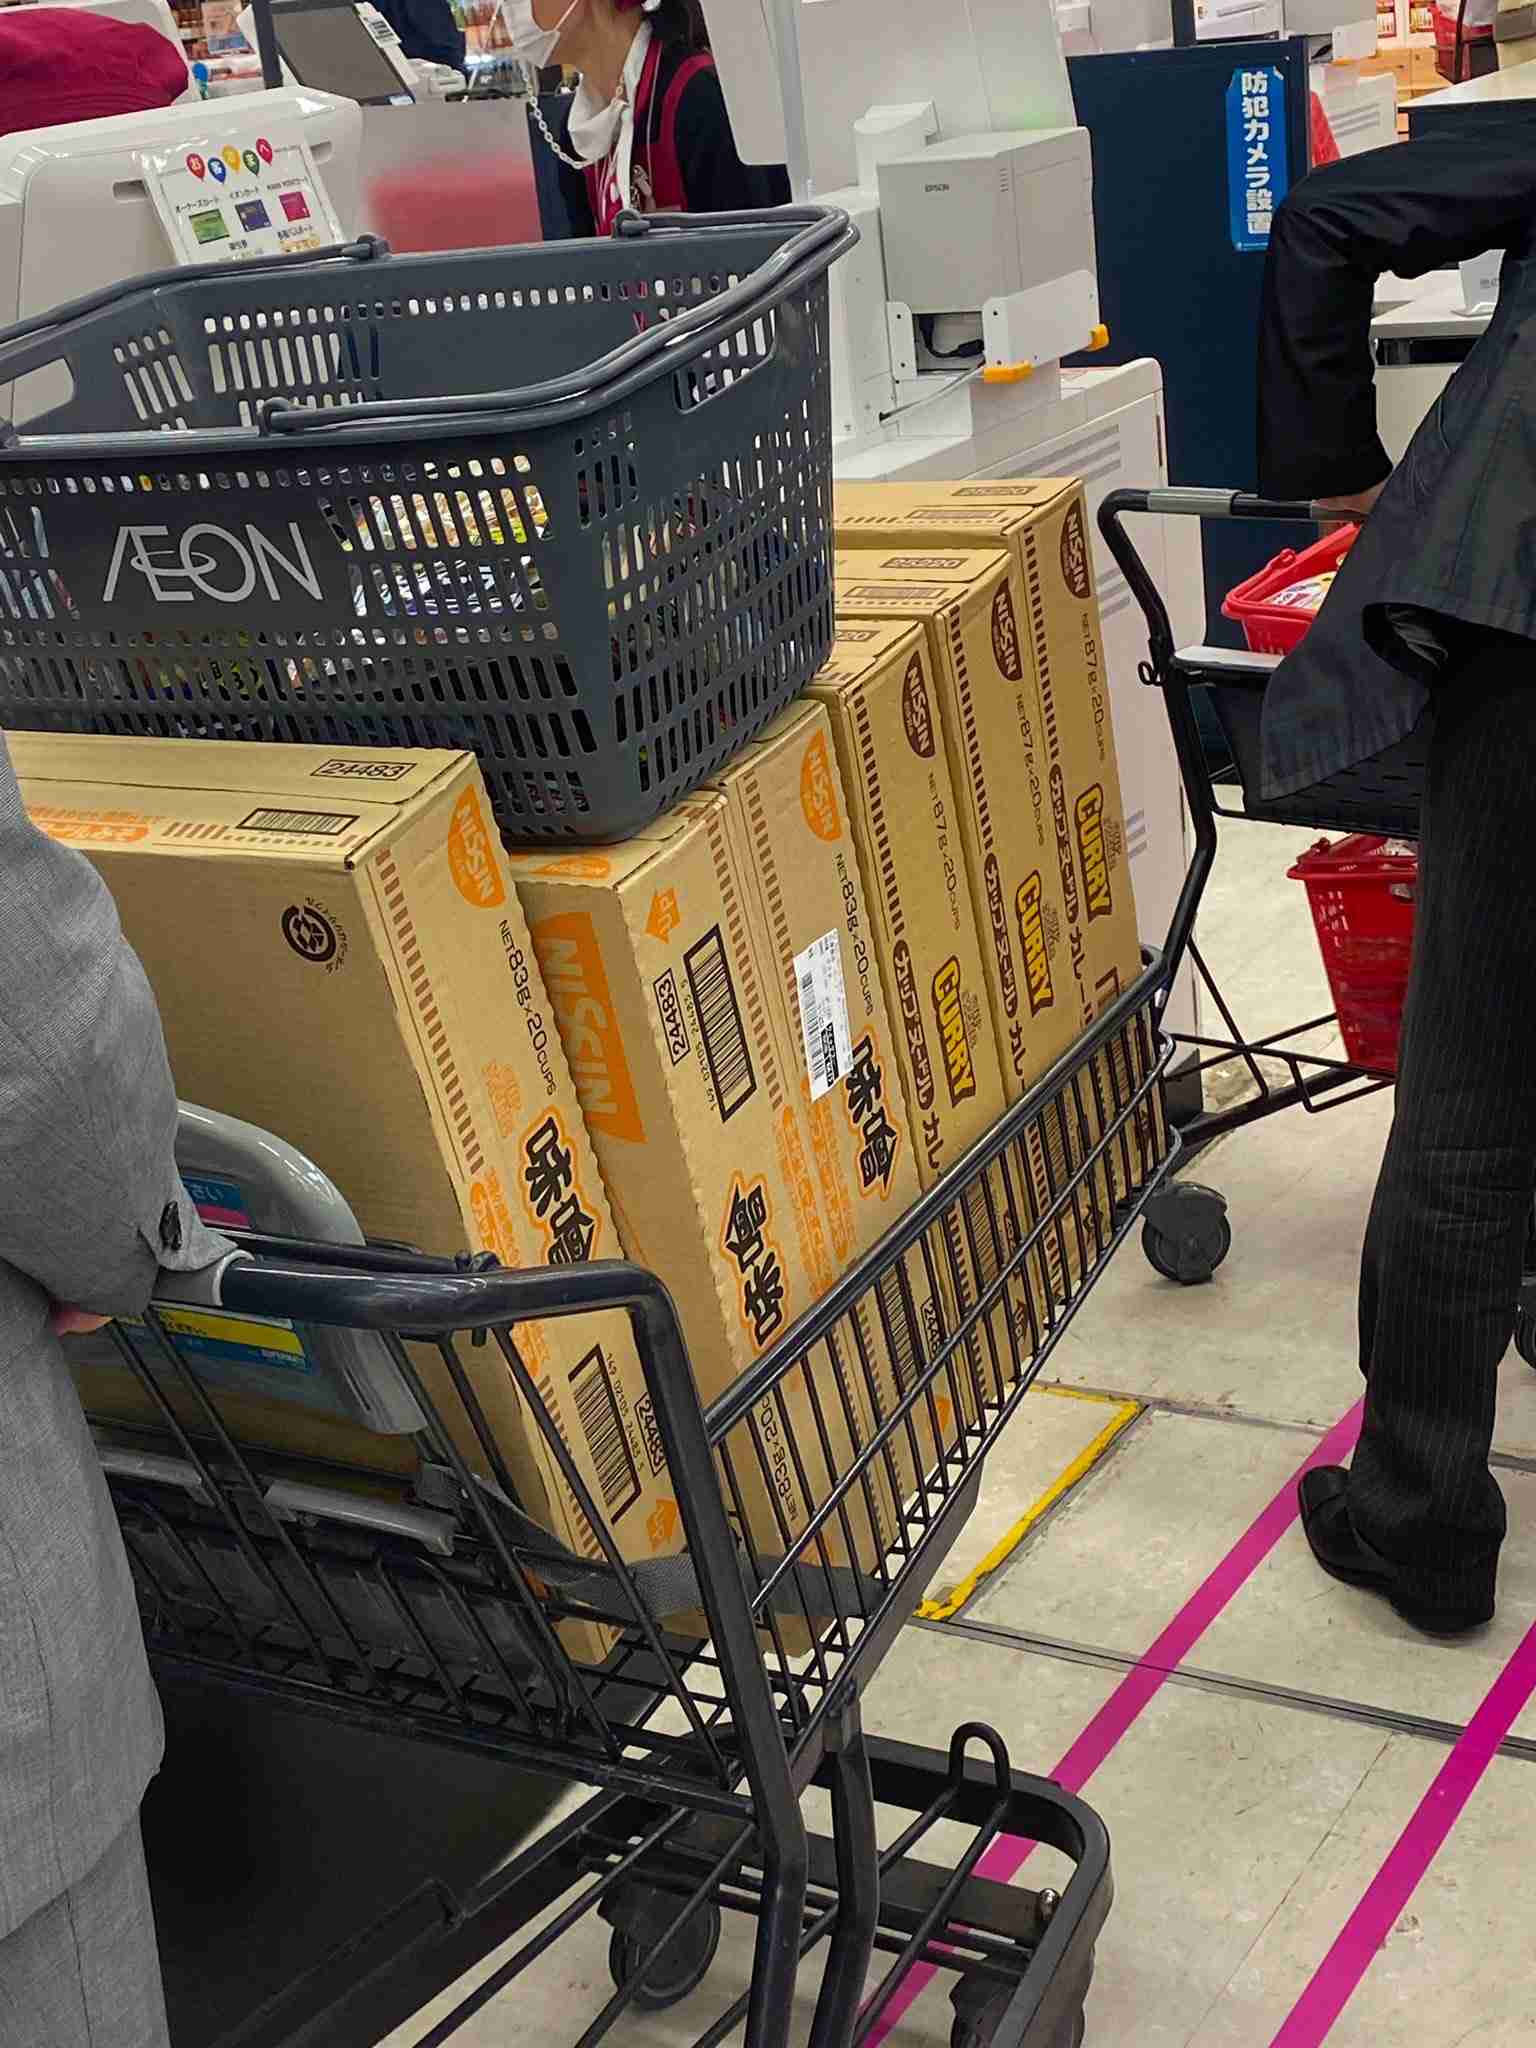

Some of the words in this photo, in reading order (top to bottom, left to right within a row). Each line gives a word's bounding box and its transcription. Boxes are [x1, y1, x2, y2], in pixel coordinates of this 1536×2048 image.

[1241, 71, 1274, 235] 防犯カメラ設置
[1066, 511, 1090, 594] NISSIN
[994, 592, 1018, 677] NISSIN
[907, 666, 931, 754] NISSIN
[321, 762, 404, 778] 24483
[808, 746, 835, 834] NISSIN
[457, 805, 495, 901] NISSIN
[1076, 785, 1112, 920] CURRY
[1017, 871, 1054, 1012] CURRY
[657, 977, 687, 1056] 24483
[934, 956, 976, 1104] CURRY
[922, 1111, 944, 1174] カレ
